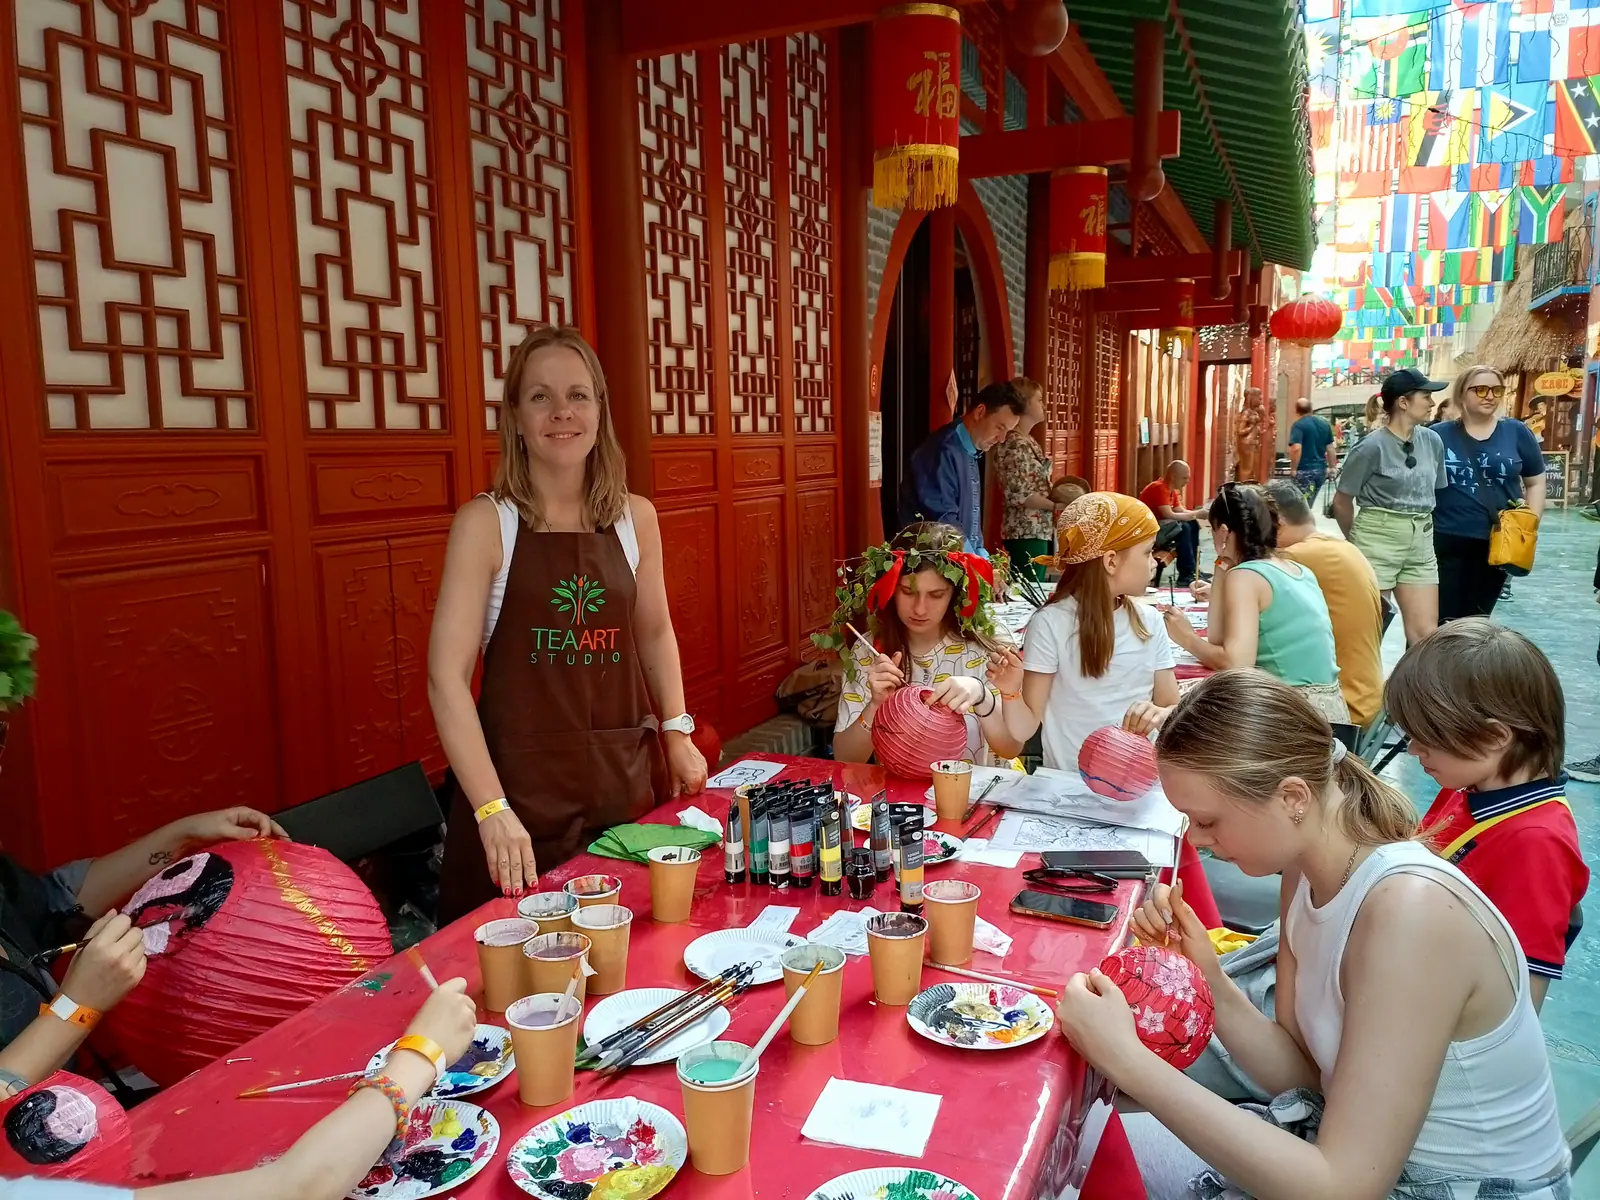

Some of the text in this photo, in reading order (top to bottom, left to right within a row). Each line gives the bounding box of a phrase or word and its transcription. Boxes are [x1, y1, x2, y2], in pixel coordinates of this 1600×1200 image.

[907, 51, 957, 118] 福
[1541, 379, 1569, 390] КАФЕ
[530, 652, 620, 665] STUDIO
